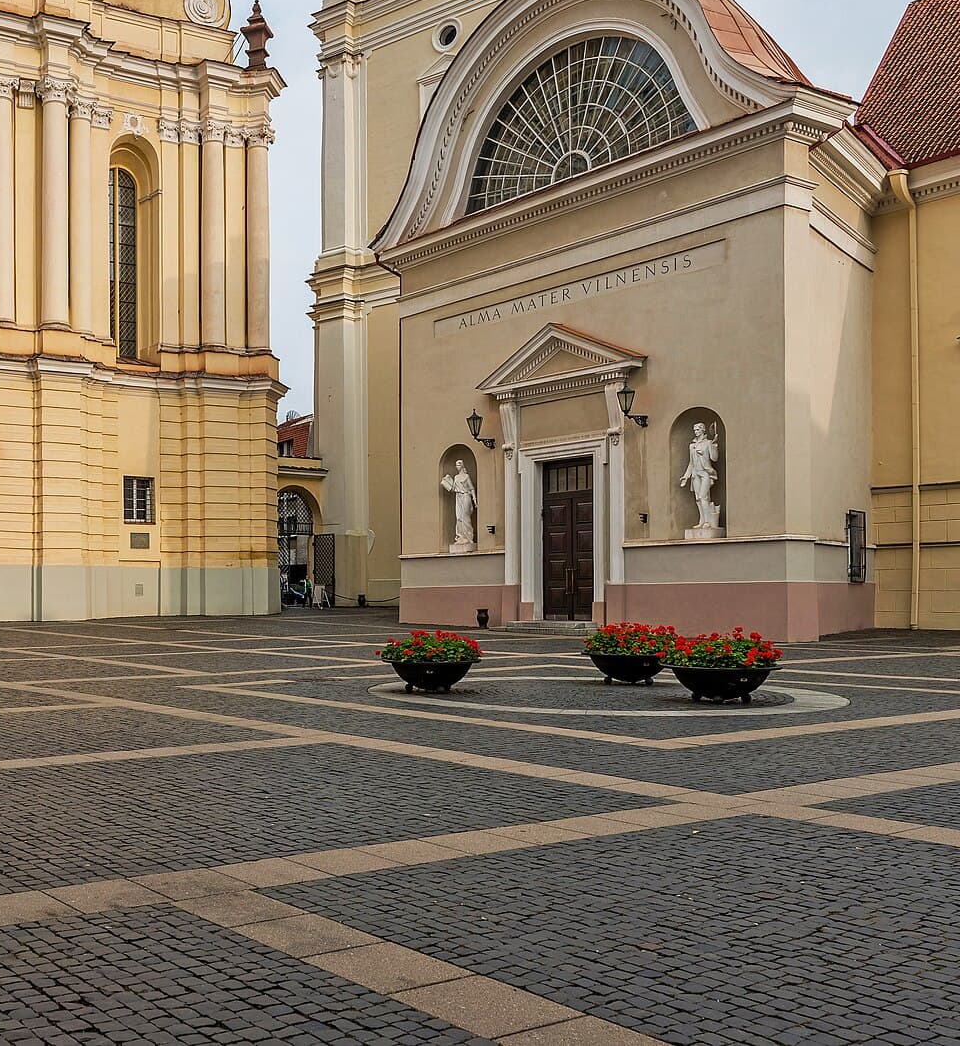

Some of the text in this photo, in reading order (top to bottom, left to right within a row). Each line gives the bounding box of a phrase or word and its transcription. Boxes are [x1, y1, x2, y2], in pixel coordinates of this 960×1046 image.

[458, 254, 692, 329] ALMA MATER VILNENSIS
